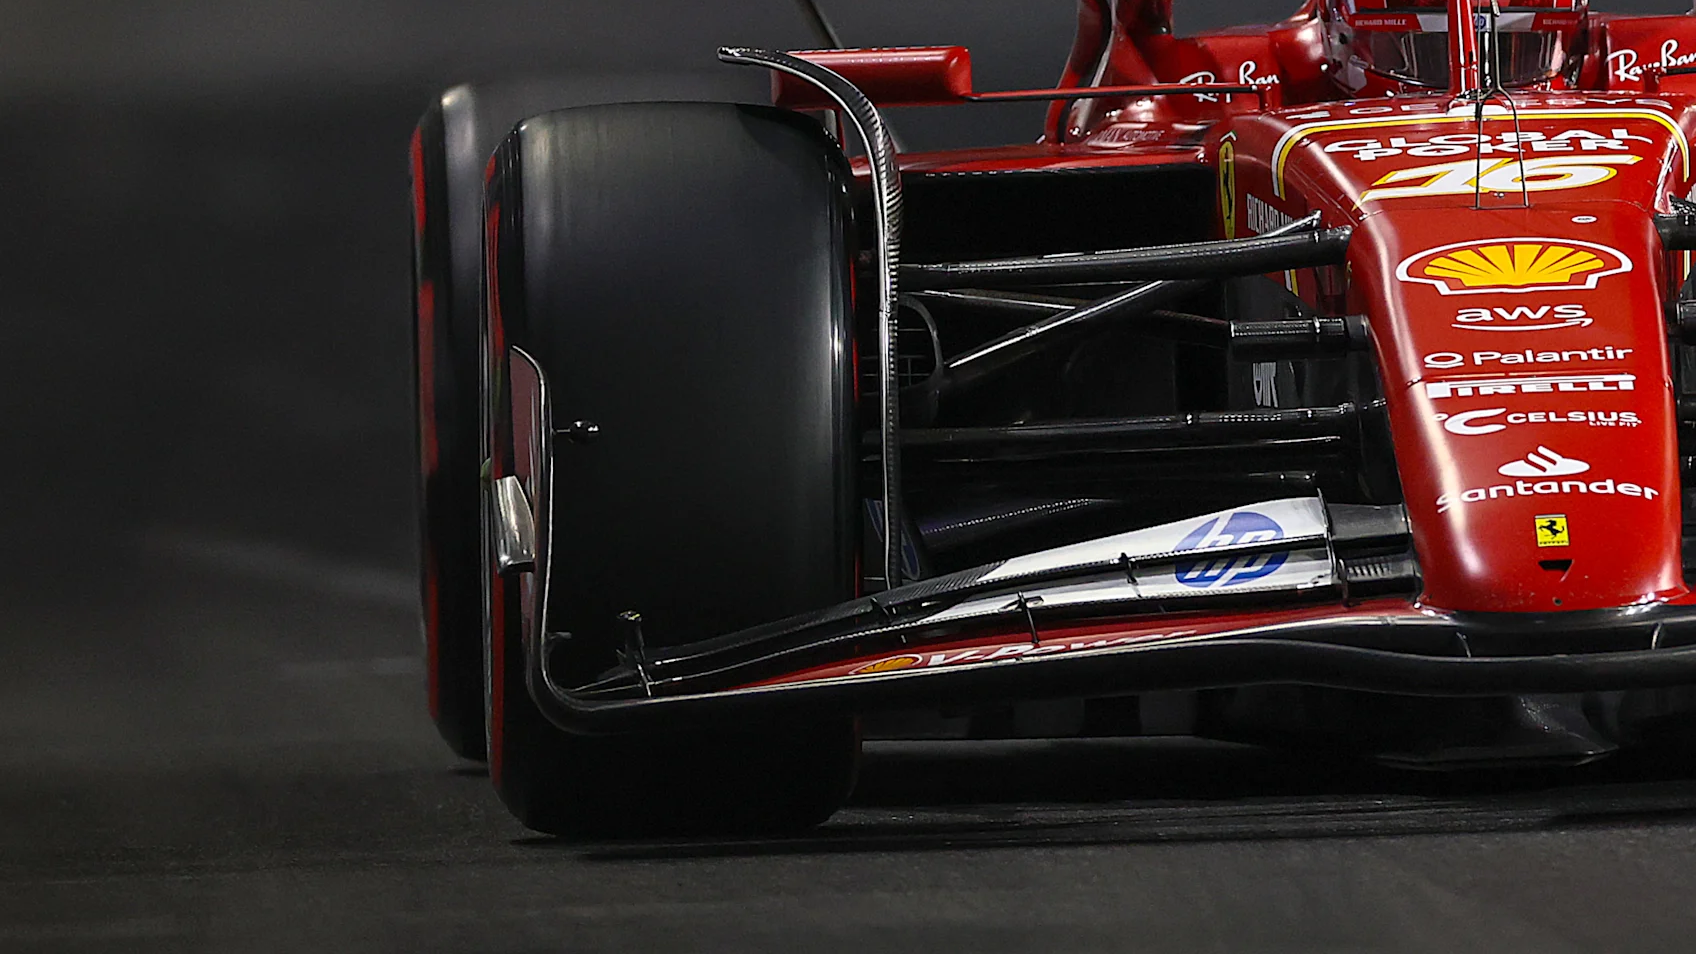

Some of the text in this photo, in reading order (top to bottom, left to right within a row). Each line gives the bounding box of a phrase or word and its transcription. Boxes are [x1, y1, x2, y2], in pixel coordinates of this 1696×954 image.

[1324, 128, 1653, 153] GLOBAL
[1353, 138, 1629, 161] POKER
[1352, 154, 1643, 211] 16
[1455, 304, 1588, 323] aws
[1472, 346, 1633, 366] Palantir
[1425, 374, 1636, 398] PIRELLI
[1507, 411, 1638, 424] CELSIUS
[1182, 514, 1286, 587] hp
